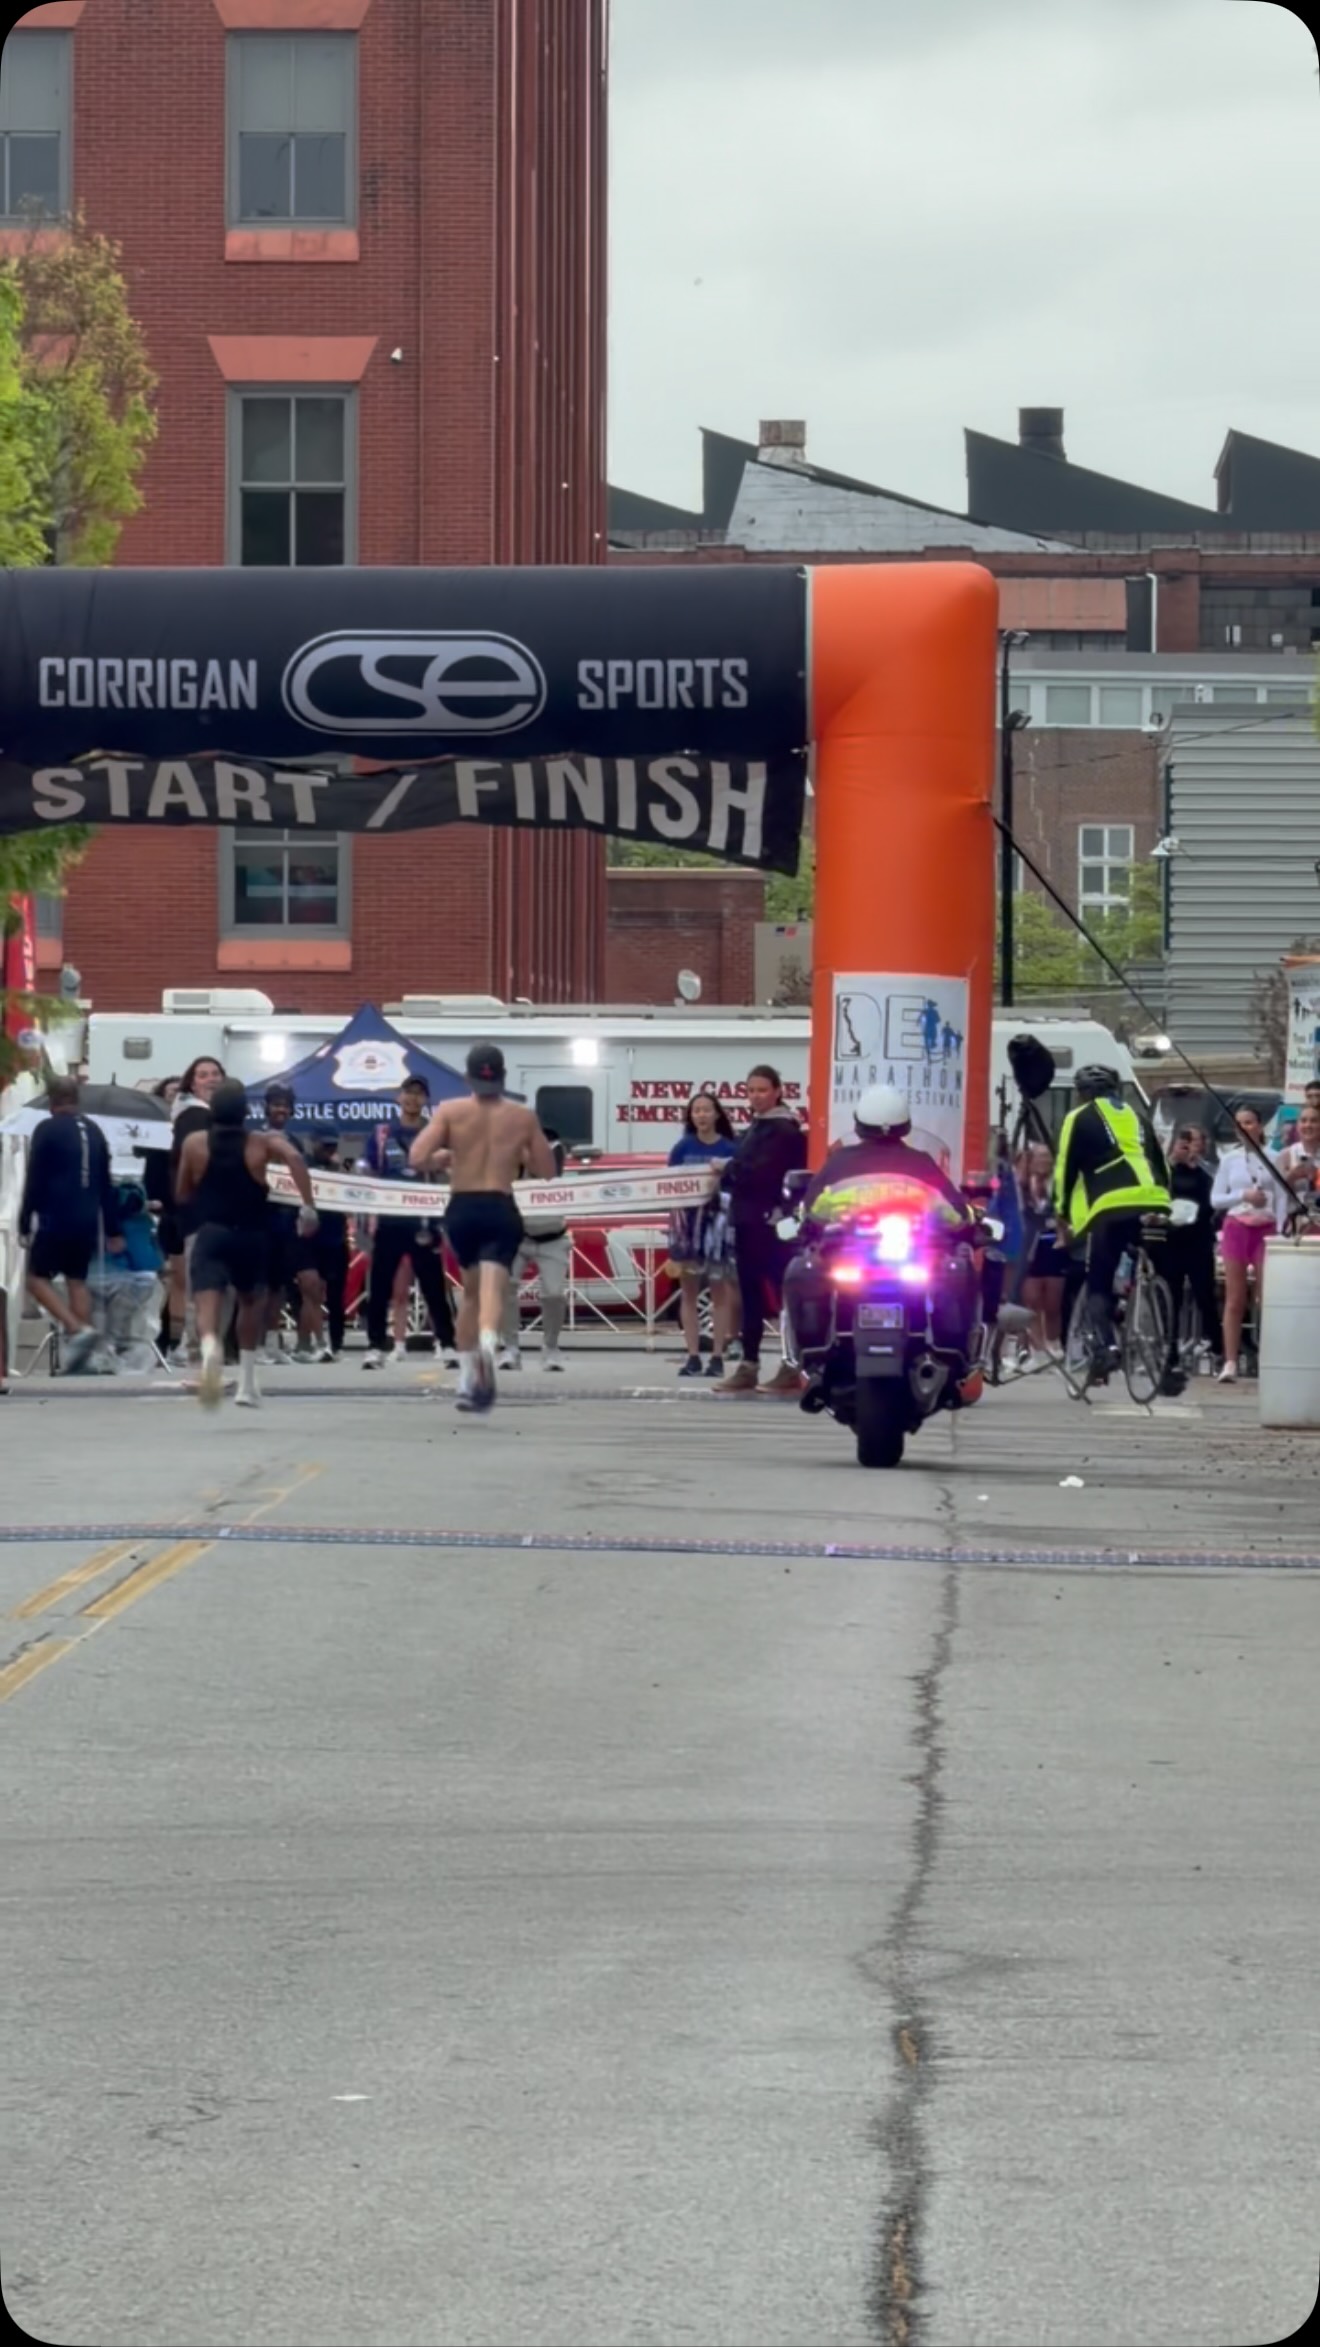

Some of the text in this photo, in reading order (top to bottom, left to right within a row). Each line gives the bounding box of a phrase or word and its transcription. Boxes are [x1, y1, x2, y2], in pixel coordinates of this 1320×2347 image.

[38, 656, 259, 711] CORRIGAN
[576, 656, 750, 711] SPORTS
[30, 758, 333, 823] START
[454, 755, 769, 861] FINISH
[630, 1080, 694, 1099] NEW
[700, 1080, 801, 1100] CASE
[833, 1064, 963, 1090] MARATHON
[338, 1101, 403, 1120] COUNTY
[530, 1179, 701, 1204] FINISH FINISH
